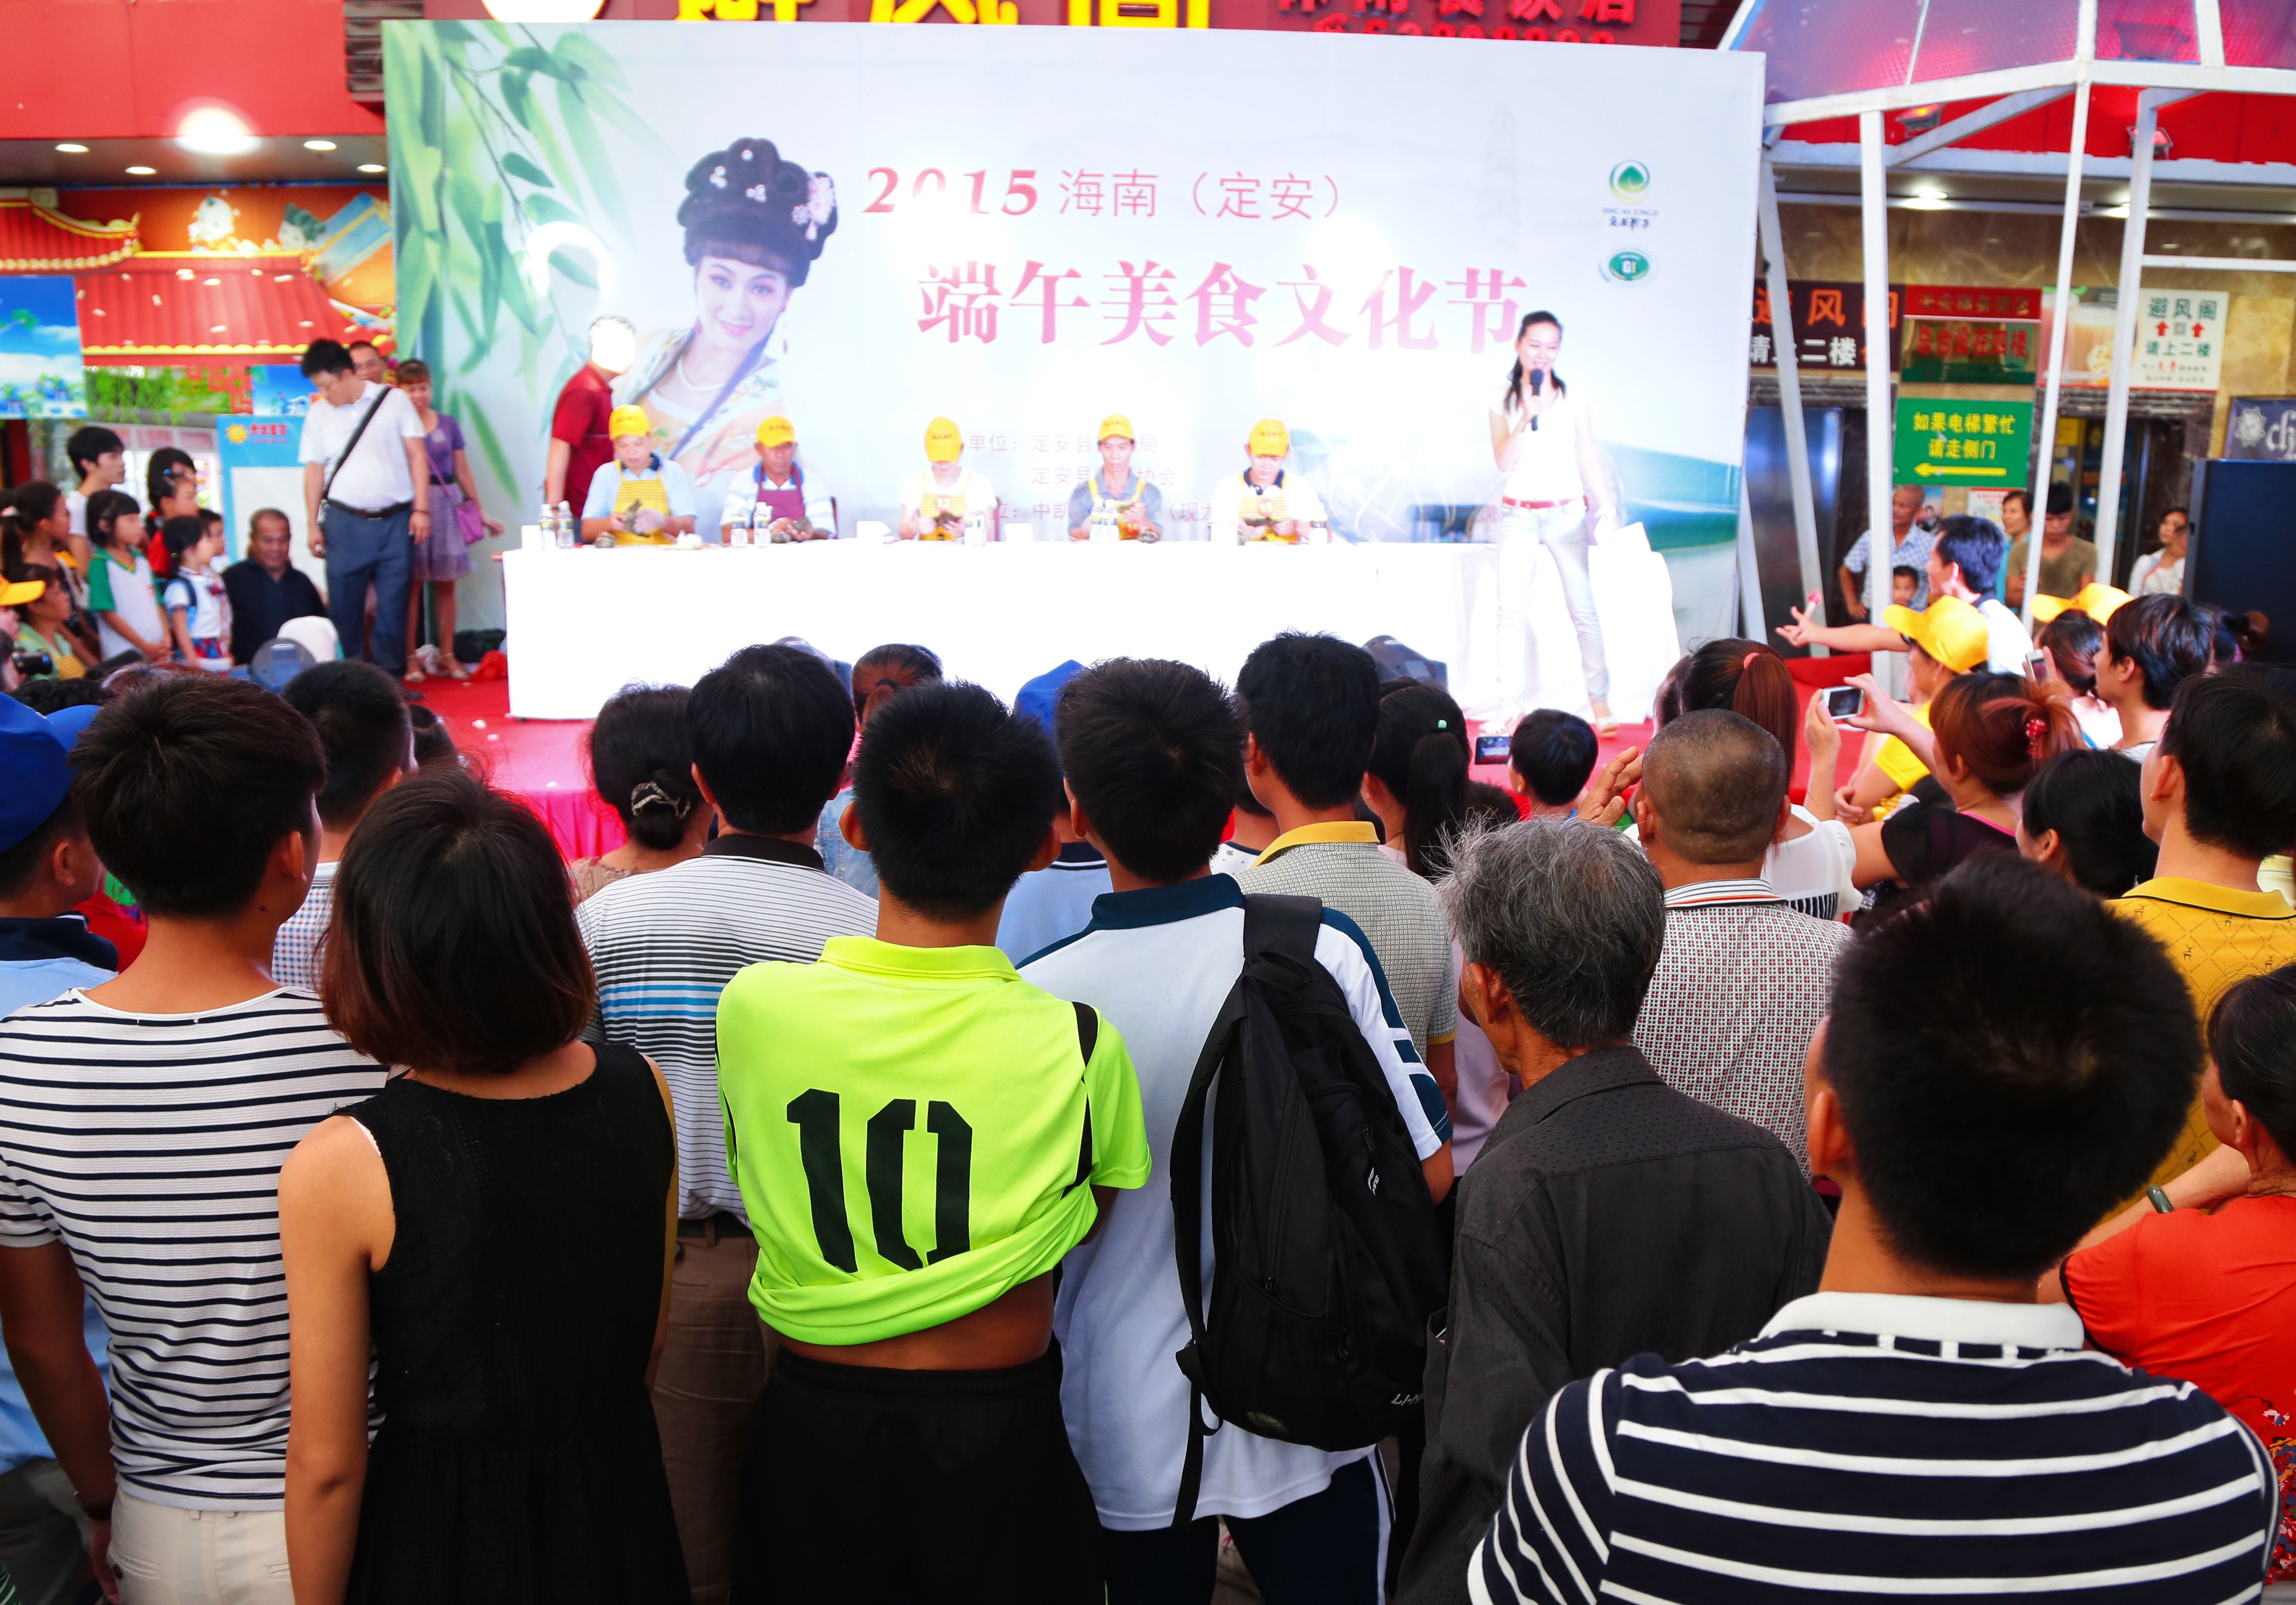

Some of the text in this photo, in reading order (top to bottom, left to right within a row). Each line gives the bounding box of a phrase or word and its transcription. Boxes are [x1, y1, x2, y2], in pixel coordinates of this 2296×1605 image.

[1059, 168, 1338, 219] 海南（定安）
[917, 259, 1528, 354] 端午美食文化节
[2149, 297, 2217, 321] 避风阁
[2146, 341, 2211, 357] 请上二楼
[1913, 411, 2016, 435] 如果电梯繁忙
[1928, 438, 1996, 460] 请走侧门
[786, 1088, 973, 1273] 10
